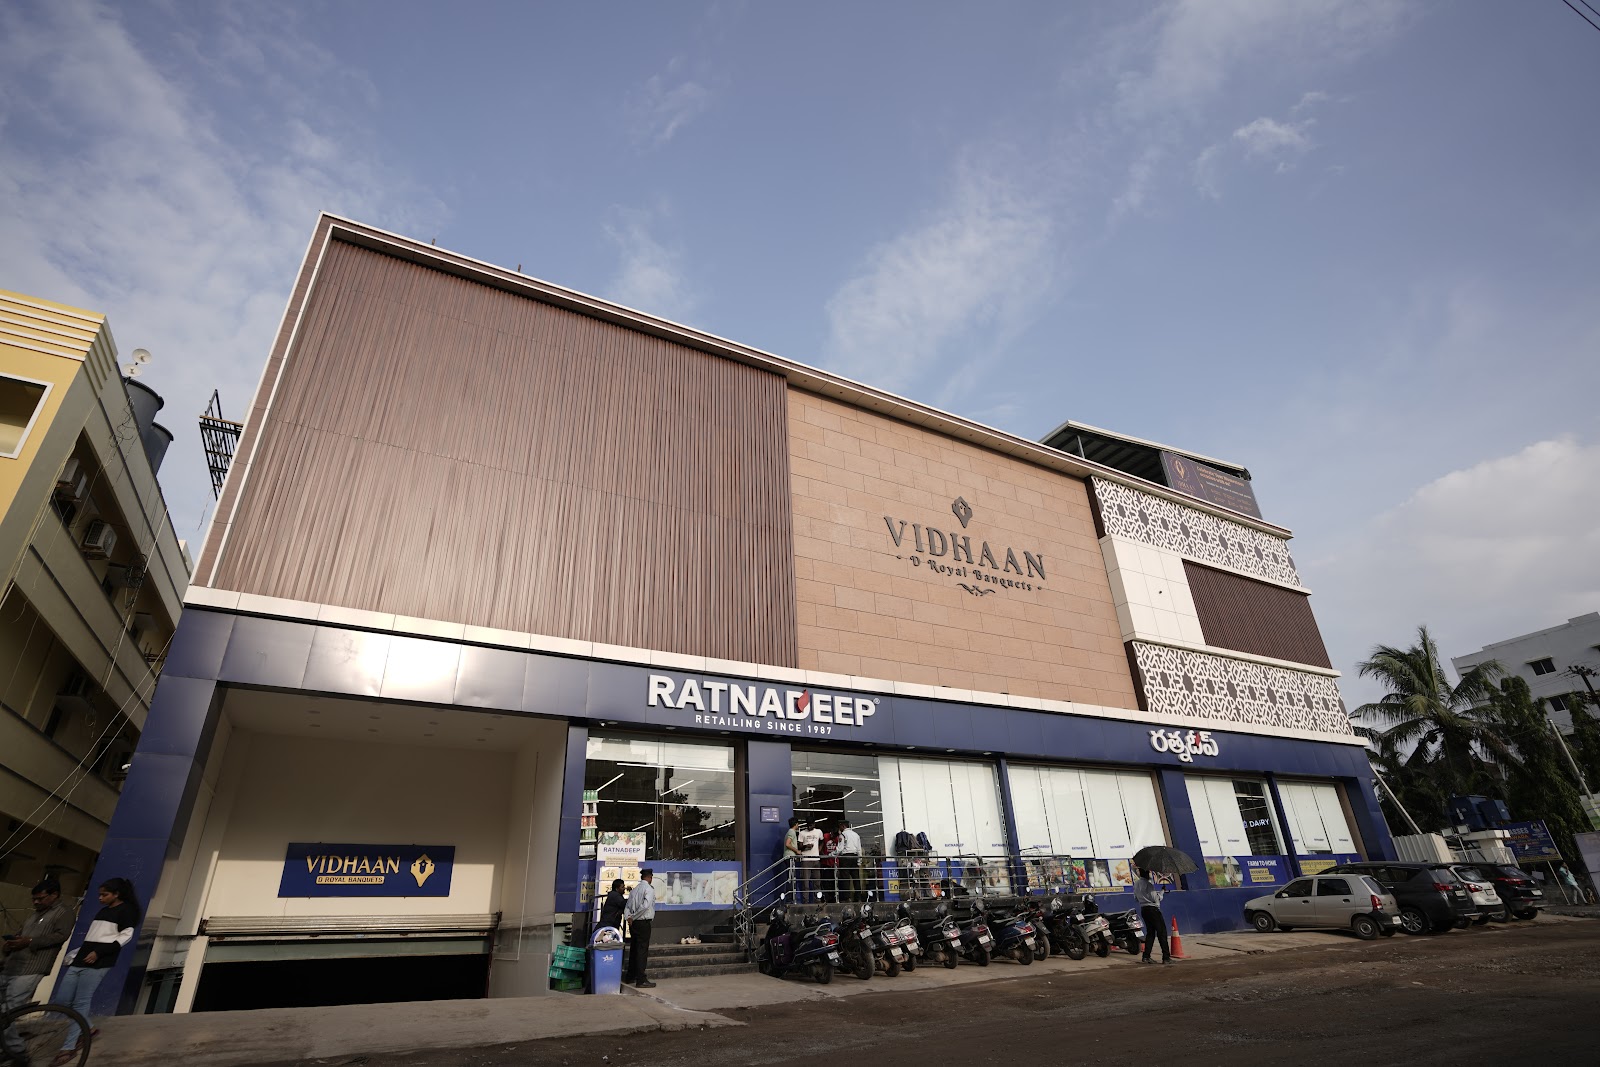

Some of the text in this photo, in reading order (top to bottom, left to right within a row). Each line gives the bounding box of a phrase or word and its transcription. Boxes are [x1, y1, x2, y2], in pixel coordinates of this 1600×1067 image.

[883, 516, 1046, 581] VIDHAAN
[927, 559, 968, 578] Royal
[972, 569, 1032, 592] Banquets
[647, 674, 876, 727] RATNADEEP
[695, 714, 833, 735] RETAILING SINCE 1987
[1249, 818, 1270, 828] DAIRY
[306, 855, 401, 875] VIDHAAN
